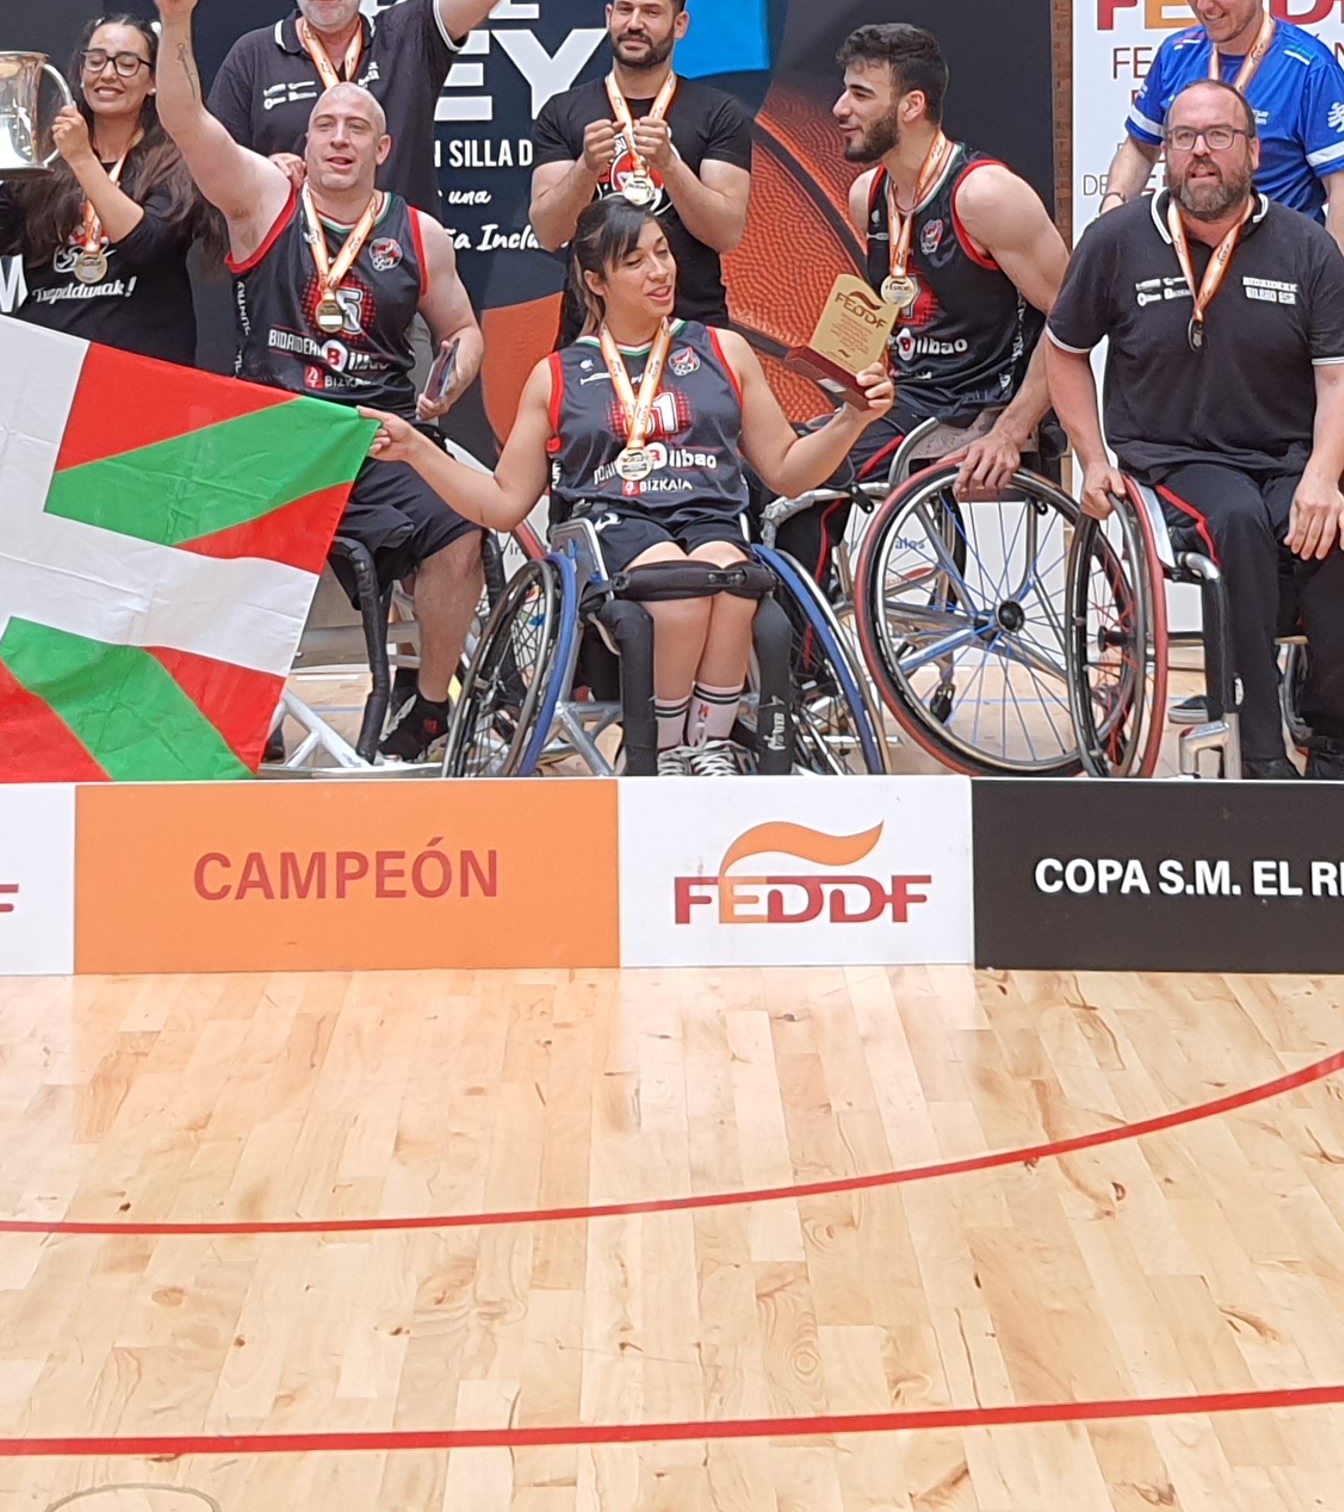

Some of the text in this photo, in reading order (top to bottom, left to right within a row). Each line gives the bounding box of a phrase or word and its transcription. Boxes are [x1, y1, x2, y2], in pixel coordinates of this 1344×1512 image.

[434, 29, 608, 121] EY
[449, 140, 513, 167] SILLA
[519, 140, 533, 166] D
[449, 190, 492, 205] una
[193, 838, 499, 902] CAMPEÓN
[1035, 857, 1149, 897] COPA
[1159, 860, 1242, 898] S.M.
[1252, 860, 1304, 899] EL
[675, 873, 932, 925] FEDDF
